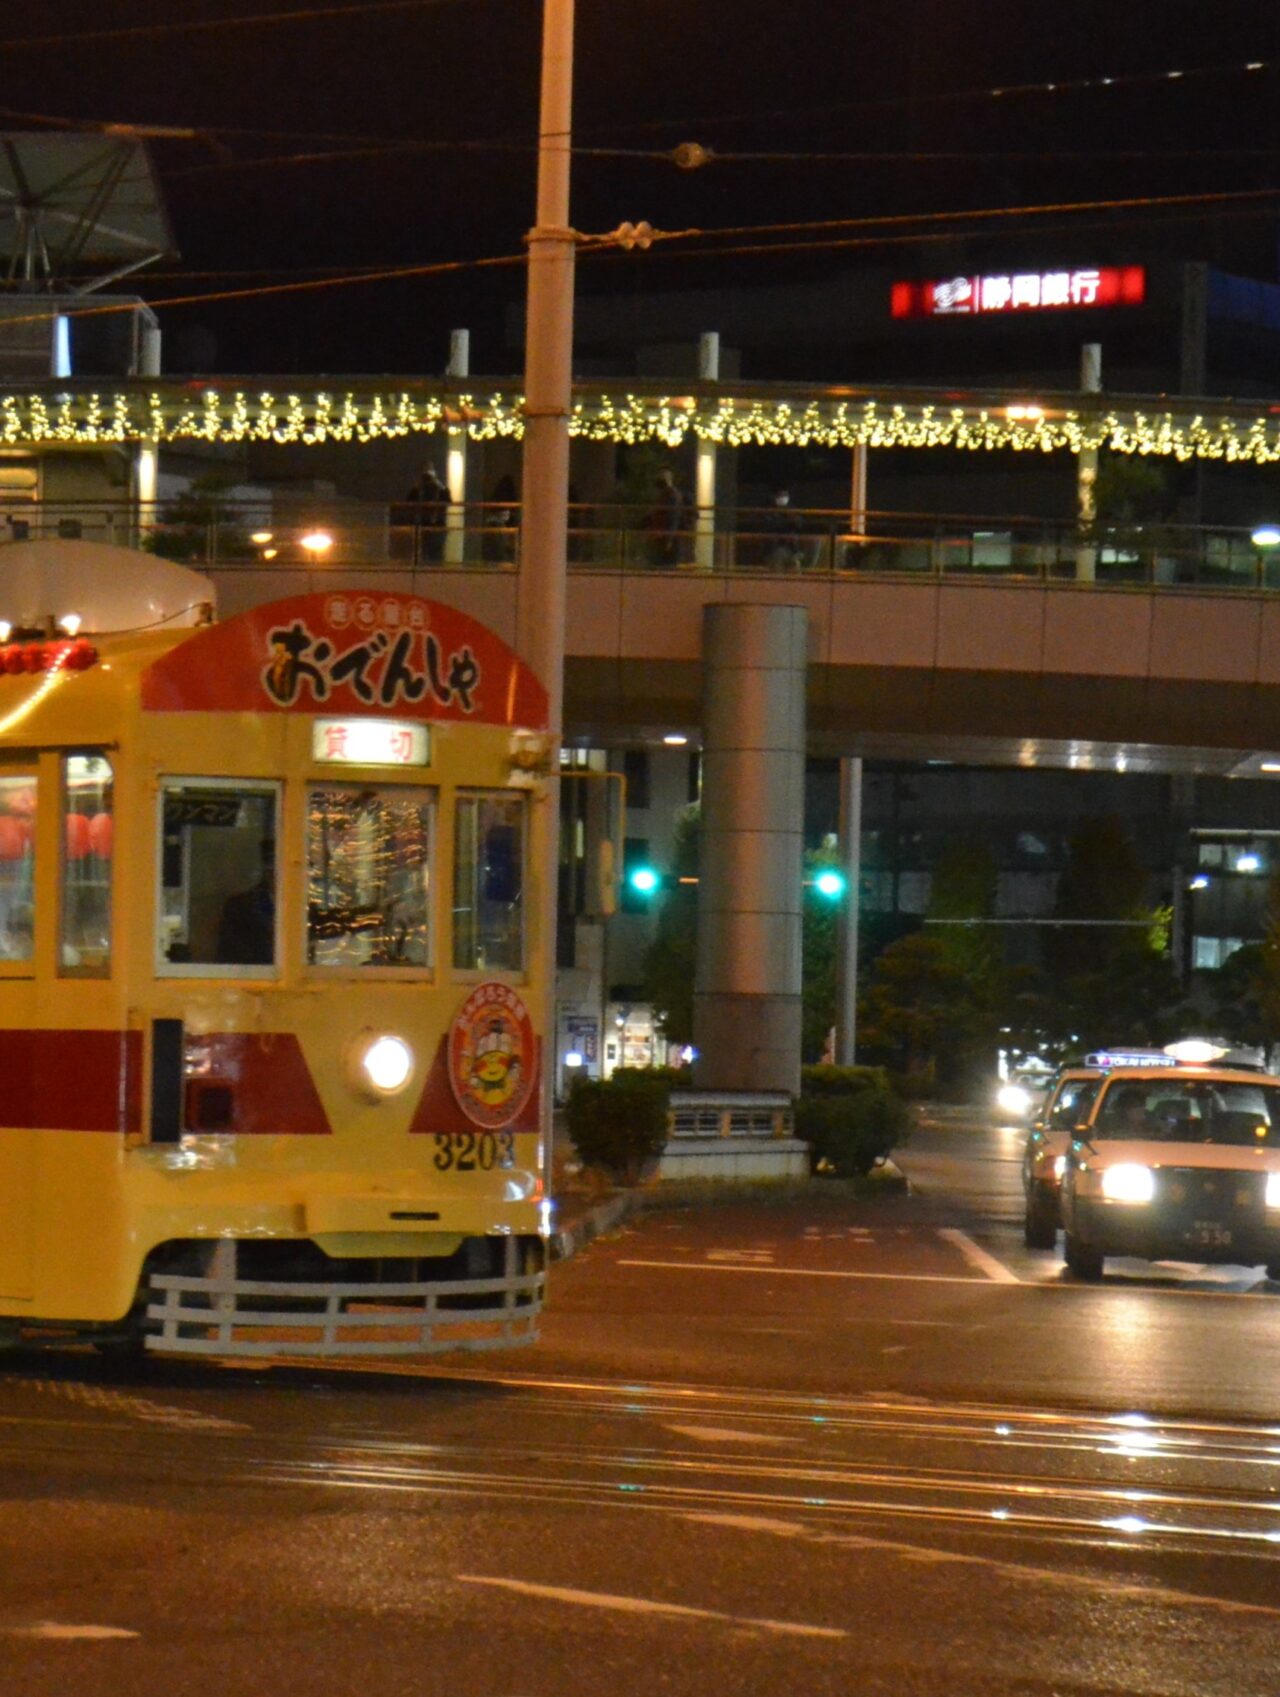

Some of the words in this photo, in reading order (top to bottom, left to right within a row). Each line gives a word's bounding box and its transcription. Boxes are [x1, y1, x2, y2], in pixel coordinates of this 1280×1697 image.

[262, 619, 480, 712] おでんしゃ
[434, 1131, 515, 1170] 3203
